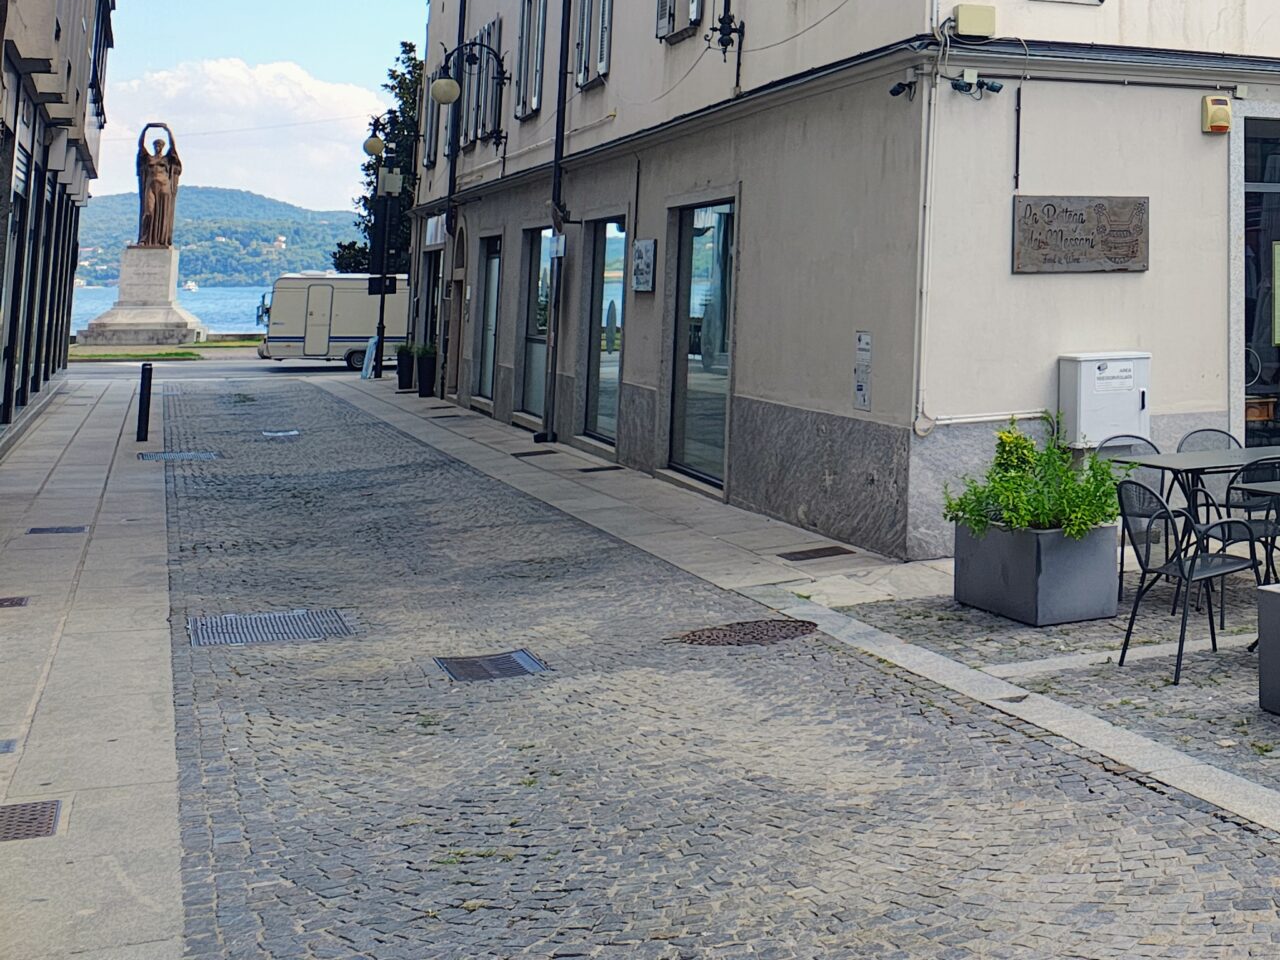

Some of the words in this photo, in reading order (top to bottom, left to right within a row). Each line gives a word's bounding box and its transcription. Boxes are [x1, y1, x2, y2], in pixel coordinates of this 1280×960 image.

[1023, 203, 1039, 225] La
[1042, 203, 1086, 233] Bottega
[1028, 229, 1043, 250] dei
